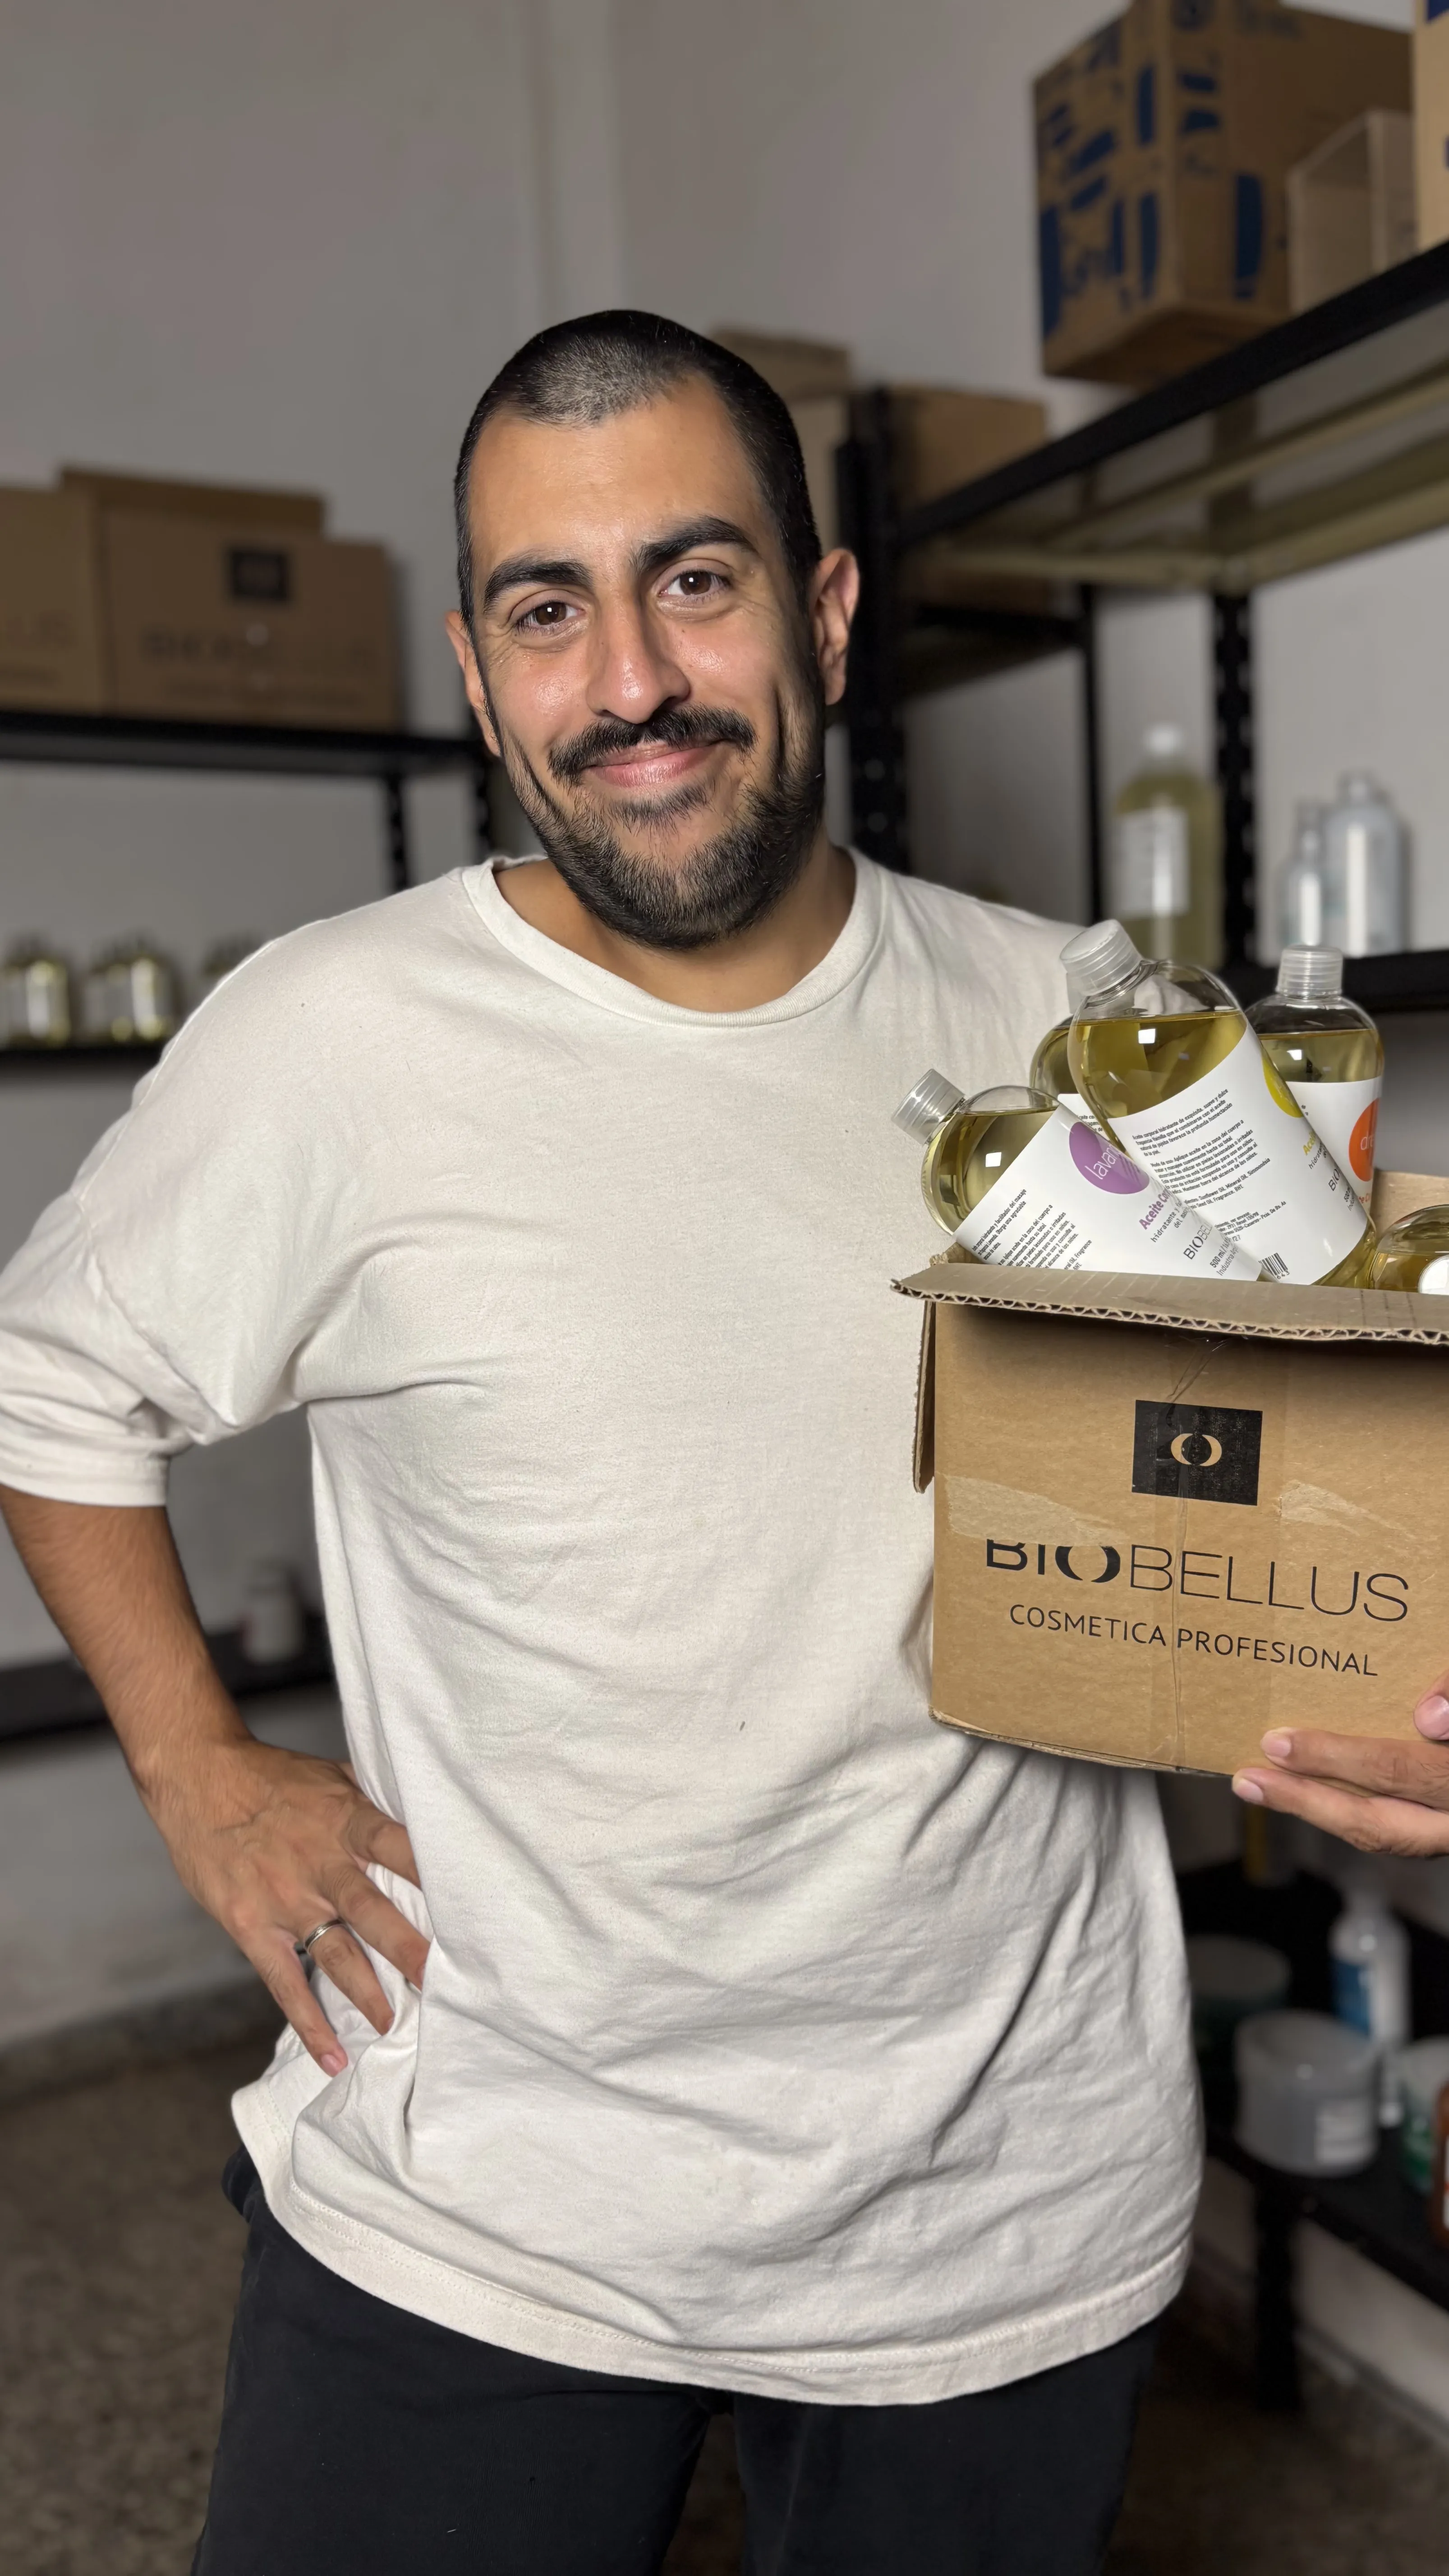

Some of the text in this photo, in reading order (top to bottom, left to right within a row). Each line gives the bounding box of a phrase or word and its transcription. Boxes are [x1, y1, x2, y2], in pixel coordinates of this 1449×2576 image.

[1218, 1089, 1228, 1098] dulce
[1214, 1100, 1226, 1110] aceite
[1228, 1122, 1241, 1133] cuerpo
[1206, 1146, 1218, 1154] hasta
[1220, 1155, 1230, 1163] para
[1026, 1226, 1035, 1234] zona
[1038, 1208, 1050, 1220] cuerpo
[1139, 1200, 1164, 1230] Aceite
[1150, 1211, 1176, 1242] hidratante
[1173, 1218, 1182, 1228] del
[1025, 1236, 1035, 1246] hasta
[1037, 1223, 1047, 1232] total
[1042, 1242, 1051, 1251] para
[1210, 1256, 1221, 1268] 500
[1216, 1254, 1234, 1276] Industria
[986, 1538, 1409, 1622] BIOBELLUS
[1009, 1604, 1378, 1677] COSMETICA PROFESIONAL
